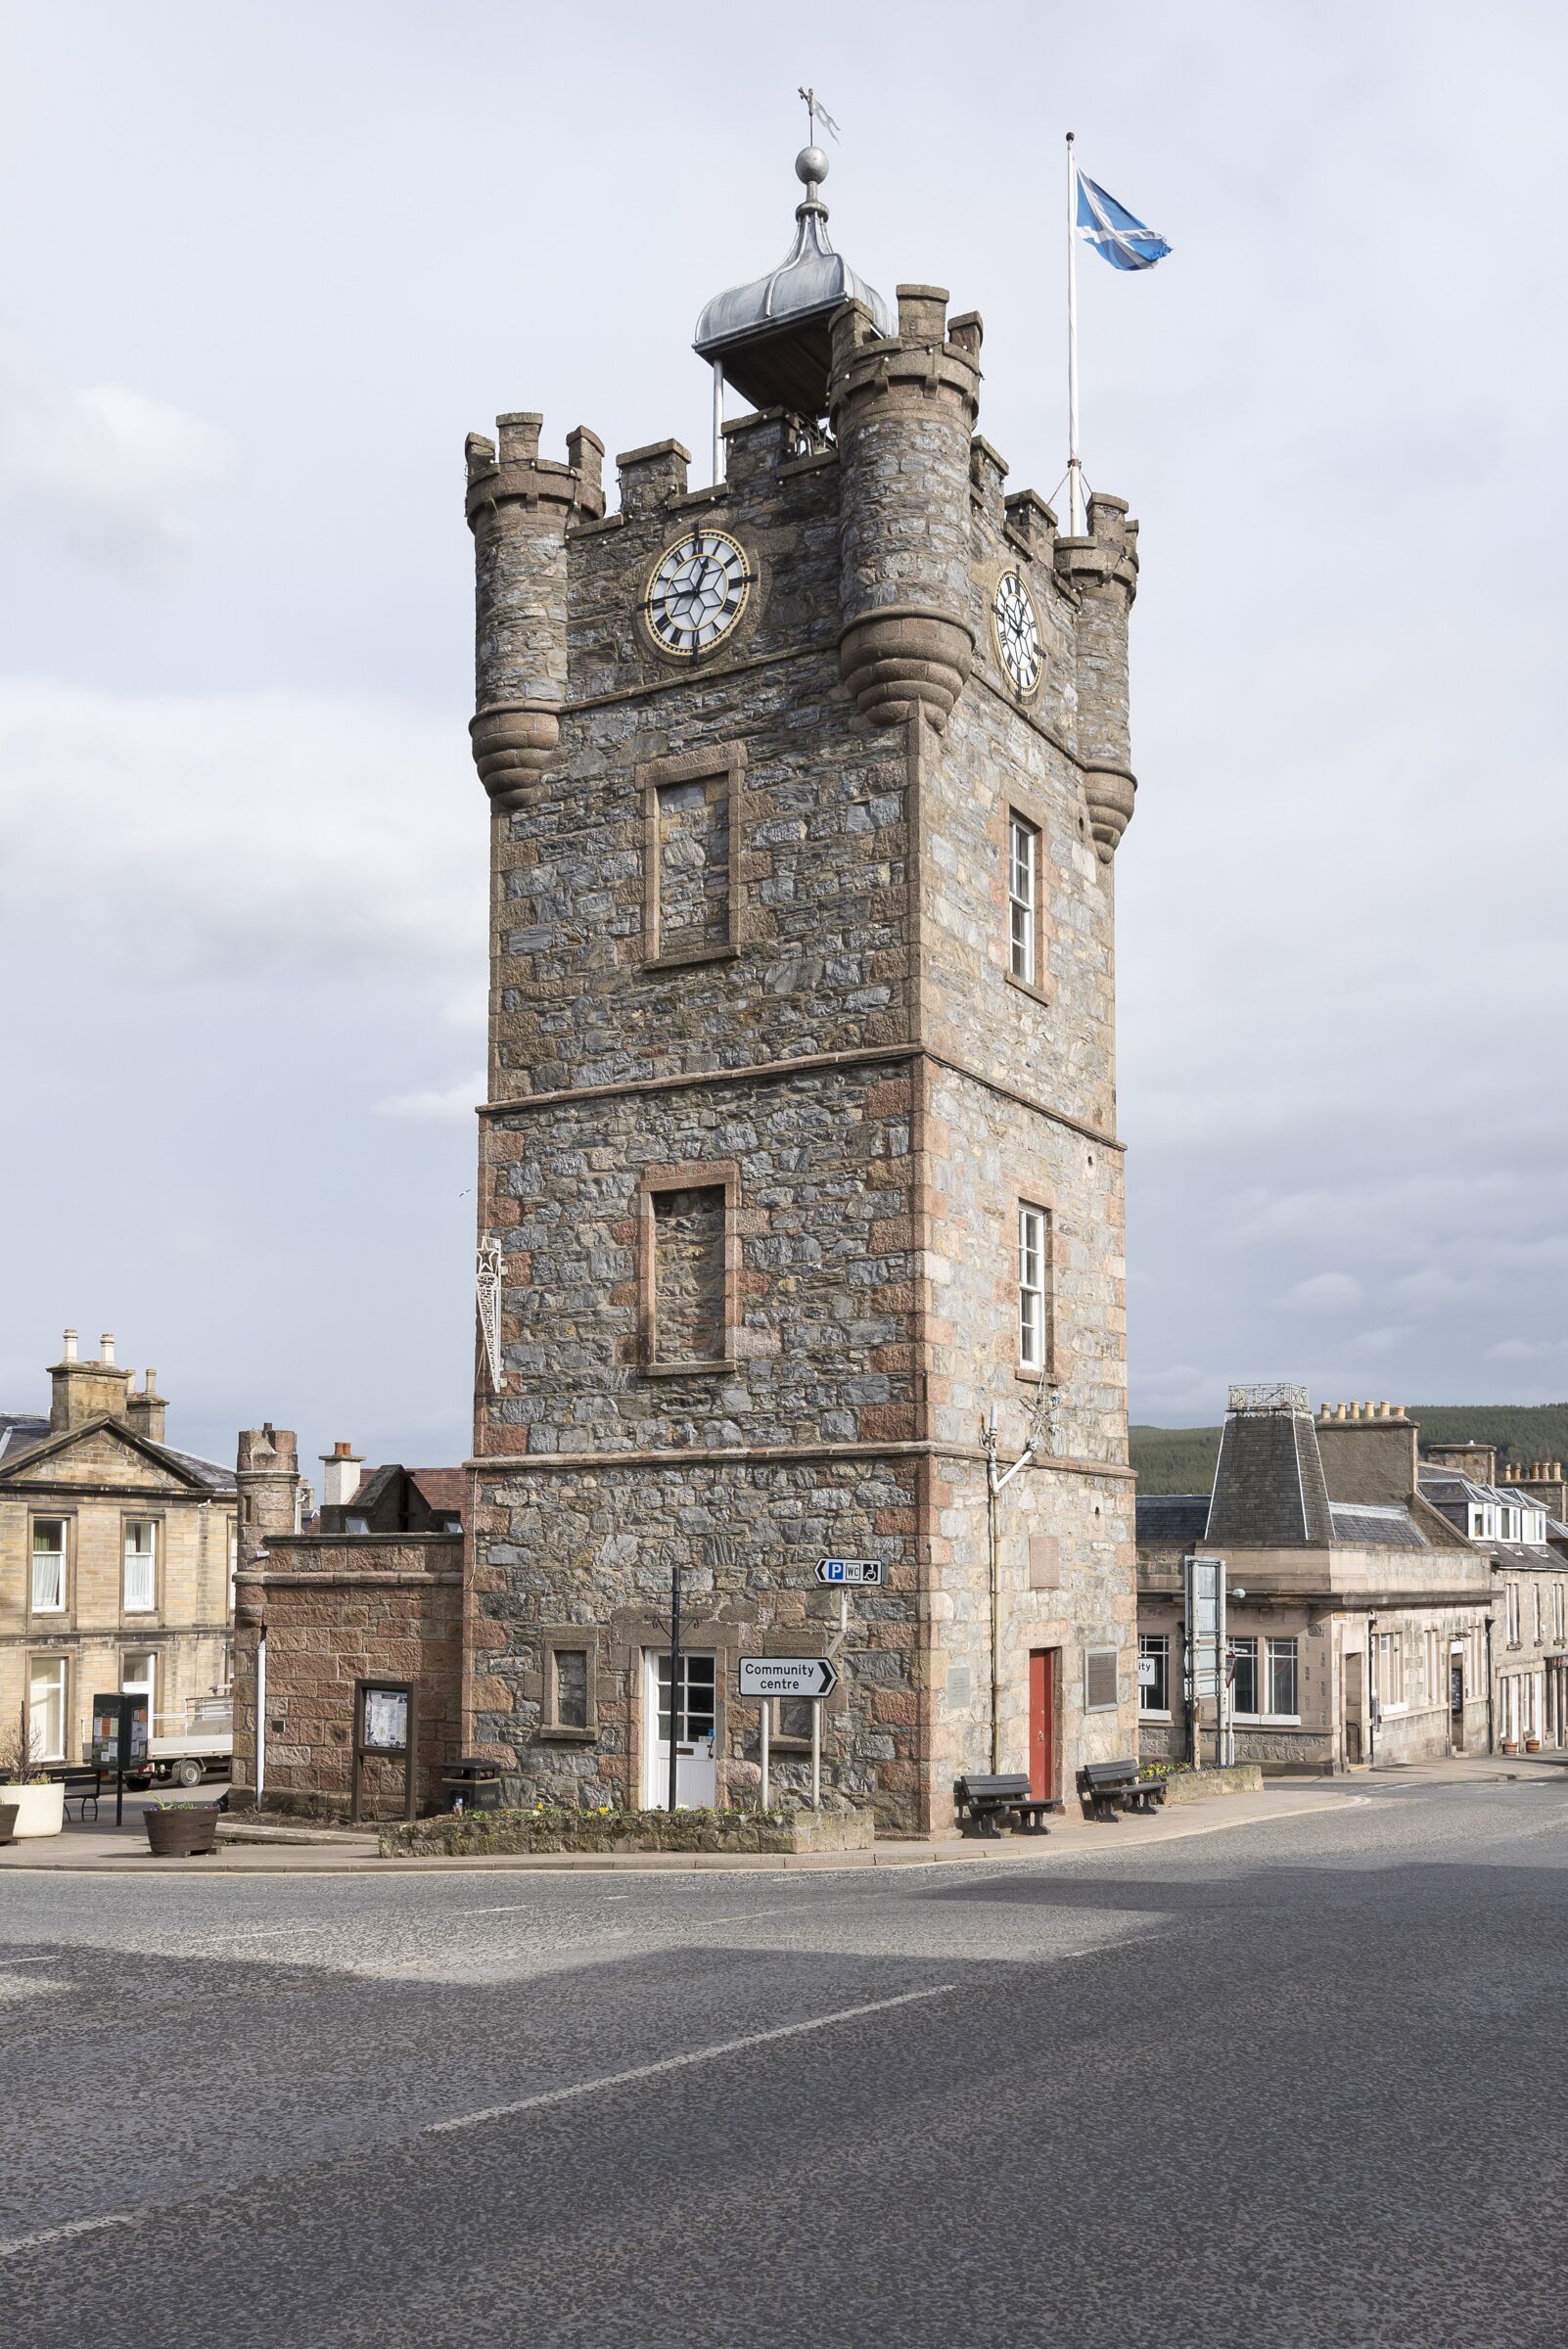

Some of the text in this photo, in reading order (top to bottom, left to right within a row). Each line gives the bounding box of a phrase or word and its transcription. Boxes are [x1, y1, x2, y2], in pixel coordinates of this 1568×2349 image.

[831, 1563, 842, 1579] P
[847, 1566, 859, 1577] WC
[745, 1663, 814, 1677] Community
[1138, 1662, 1151, 1672] ity
[760, 1679, 800, 1689] centre
